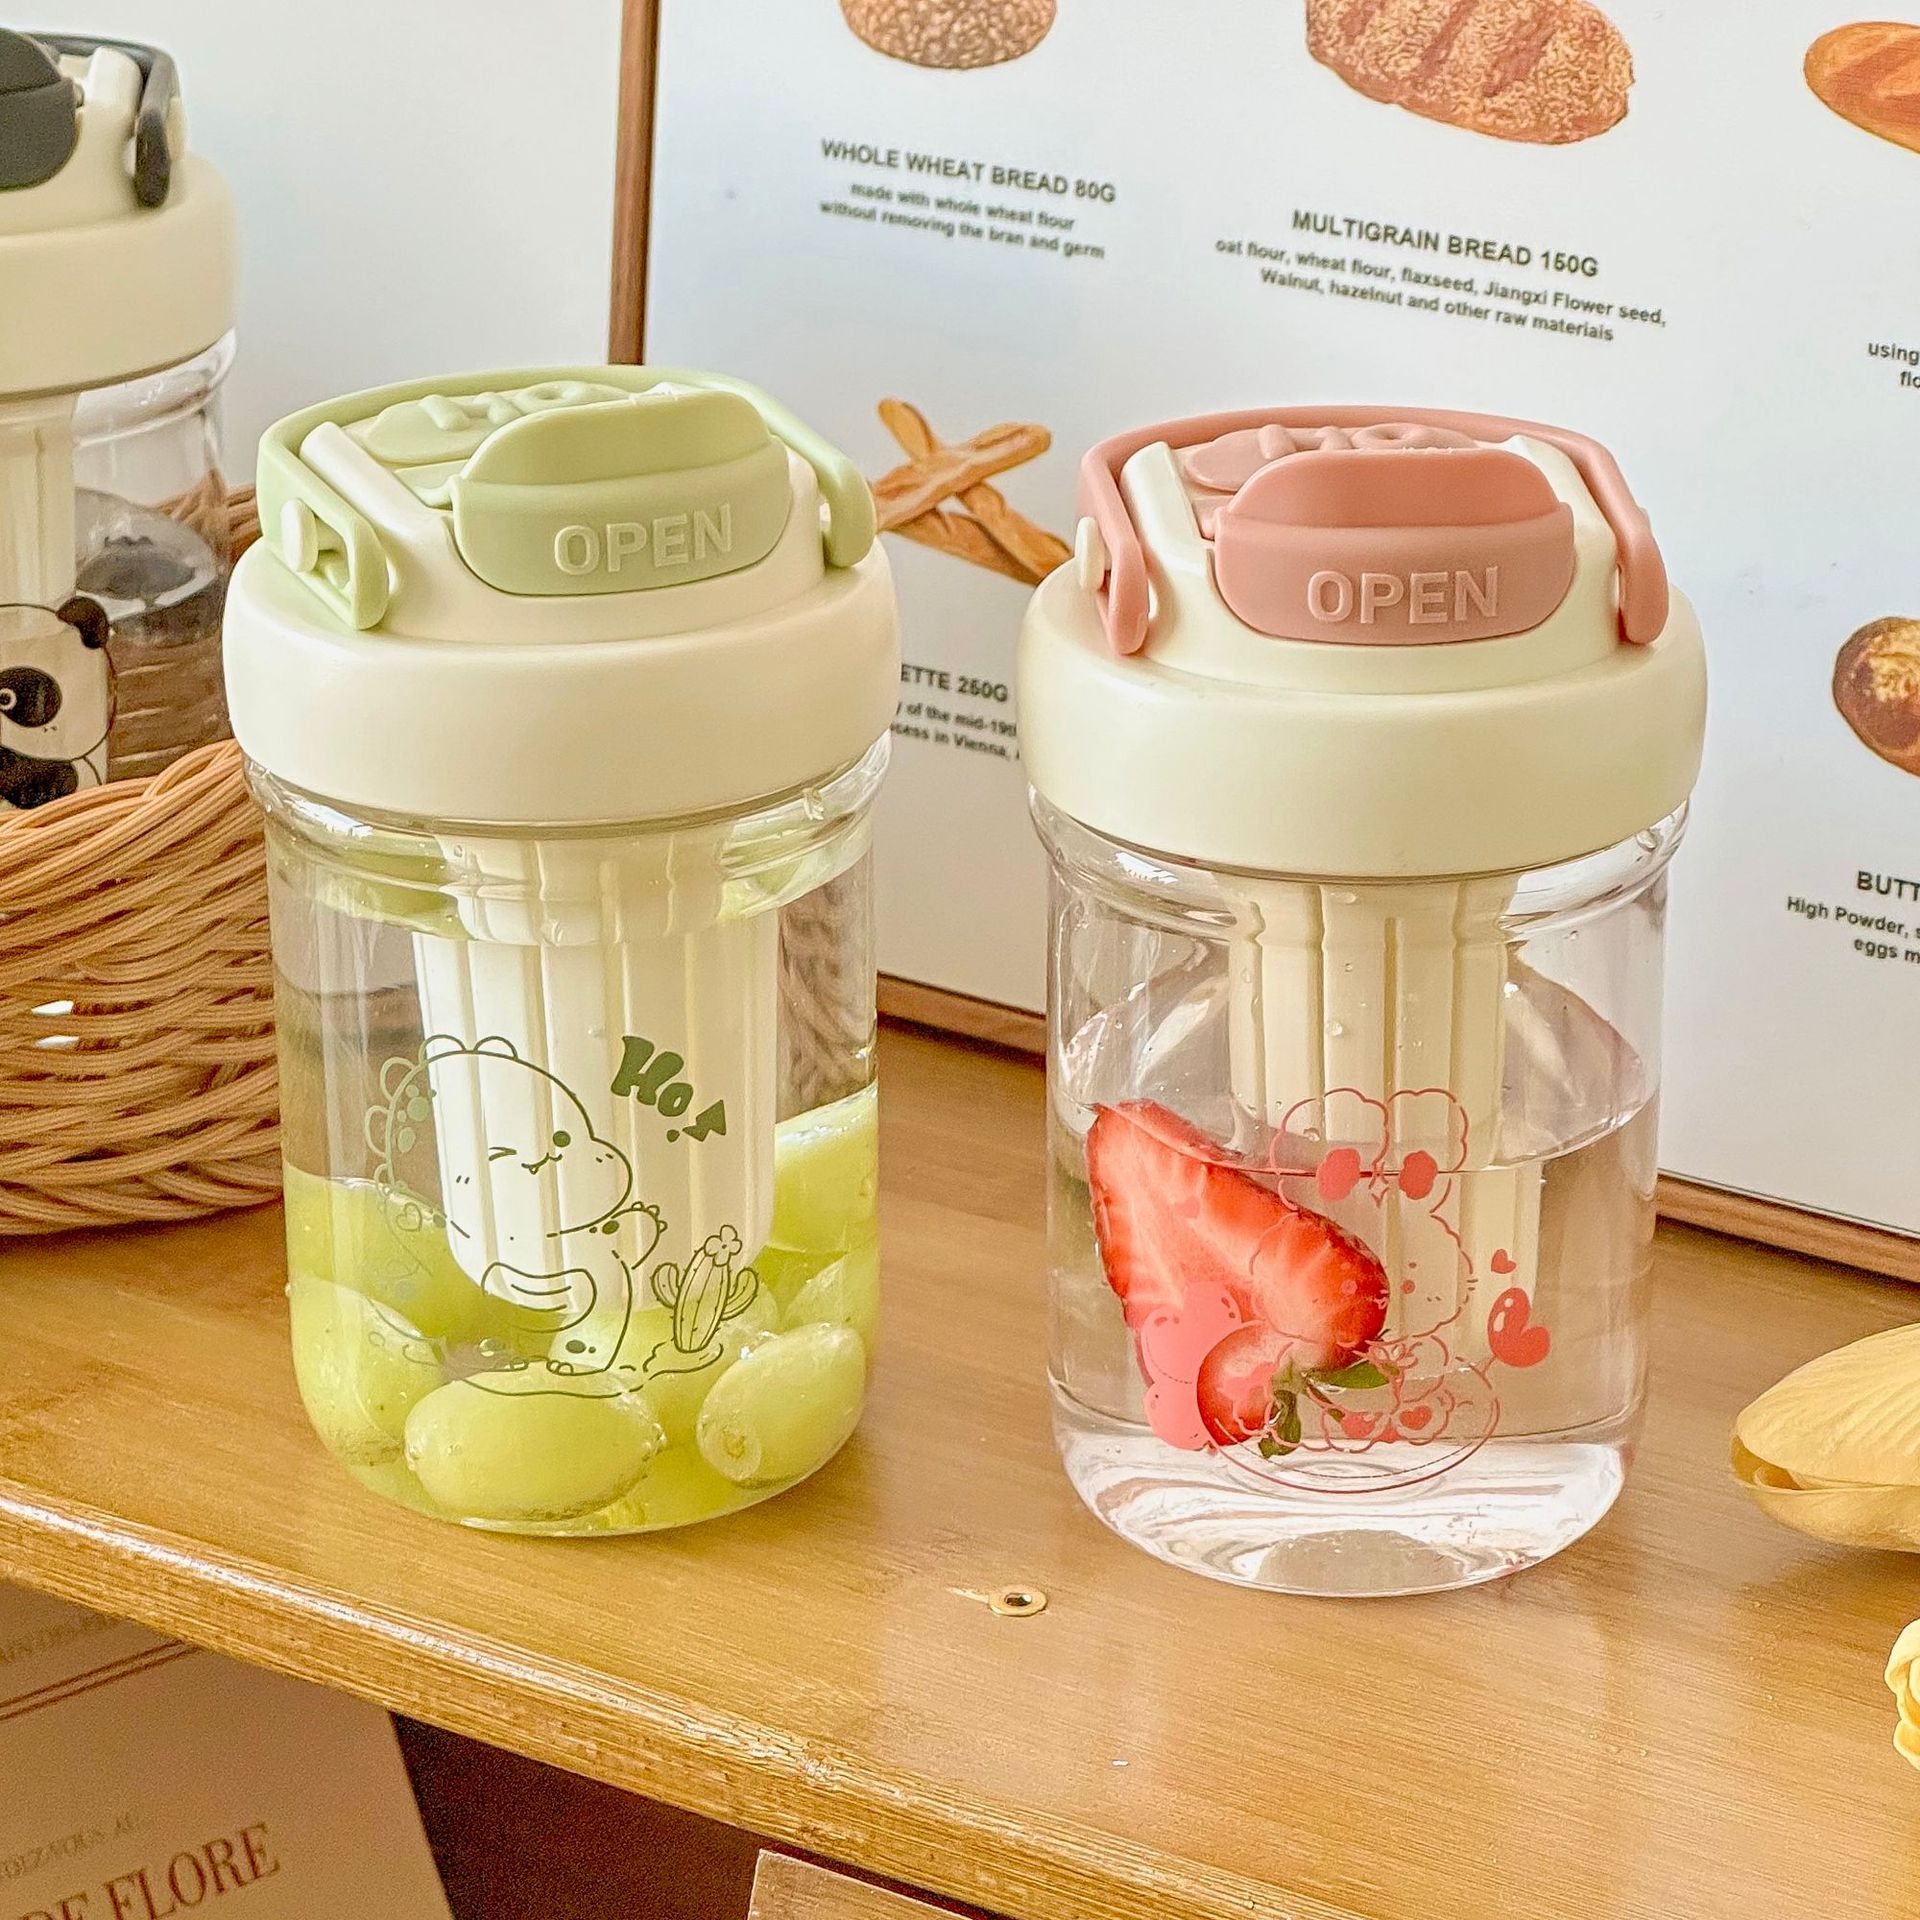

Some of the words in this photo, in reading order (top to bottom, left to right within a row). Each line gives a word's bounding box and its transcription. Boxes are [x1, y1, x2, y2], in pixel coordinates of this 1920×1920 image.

[821, 138, 899, 168] WHOLE
[905, 152, 985, 182] WHEAT
[991, 165, 1068, 195] BREAD
[1075, 178, 1116, 203] 80G
[819, 198, 877, 221] without
[881, 211, 955, 238] removing
[959, 221, 984, 239] the
[988, 226, 1025, 246] bran
[1029, 235, 1060, 252] and
[1062, 240, 1106, 259] germ
[850, 183, 892, 201] made
[897, 190, 930, 207] with
[934, 197, 980, 215] whole
[986, 204, 1033, 224] wheat
[1037, 210, 1076, 231] flour
[1292, 208, 1440, 252] MULTIGRAIN
[1447, 233, 1532, 266] BREAD
[1540, 248, 1599, 278] 150G
[1214, 239, 1243, 255] oat
[1246, 240, 1291, 266] flour,
[1294, 250, 1347, 272] wheat
[1350, 256, 1396, 283] flour,
[1401, 266, 1479, 297] flaxseed,
[1483, 279, 1548, 307] Jiangxi
[1552, 291, 1615, 316] Flower
[1618, 305, 1667, 328] seed,
[1260, 266, 1325, 295] Walnut,
[1328, 279, 1403, 307] hazelnut
[1406, 294, 1441, 312] and
[1443, 300, 1491, 320] other
[1495, 310, 1528, 327] raw
[1867, 342, 1920, 366] using
[554, 503, 732, 576] OPEN
[1307, 565, 1499, 625] OPEN
[925, 704, 951, 723] the
[957, 675, 1009, 703] 250G
[1856, 869, 1920, 902] BUTT
[1786, 895, 1830, 920] High
[1834, 905, 1910, 939] Powder,
[1853, 937, 1899, 960] eggs
[102, 1822, 281, 1920] FLORE
